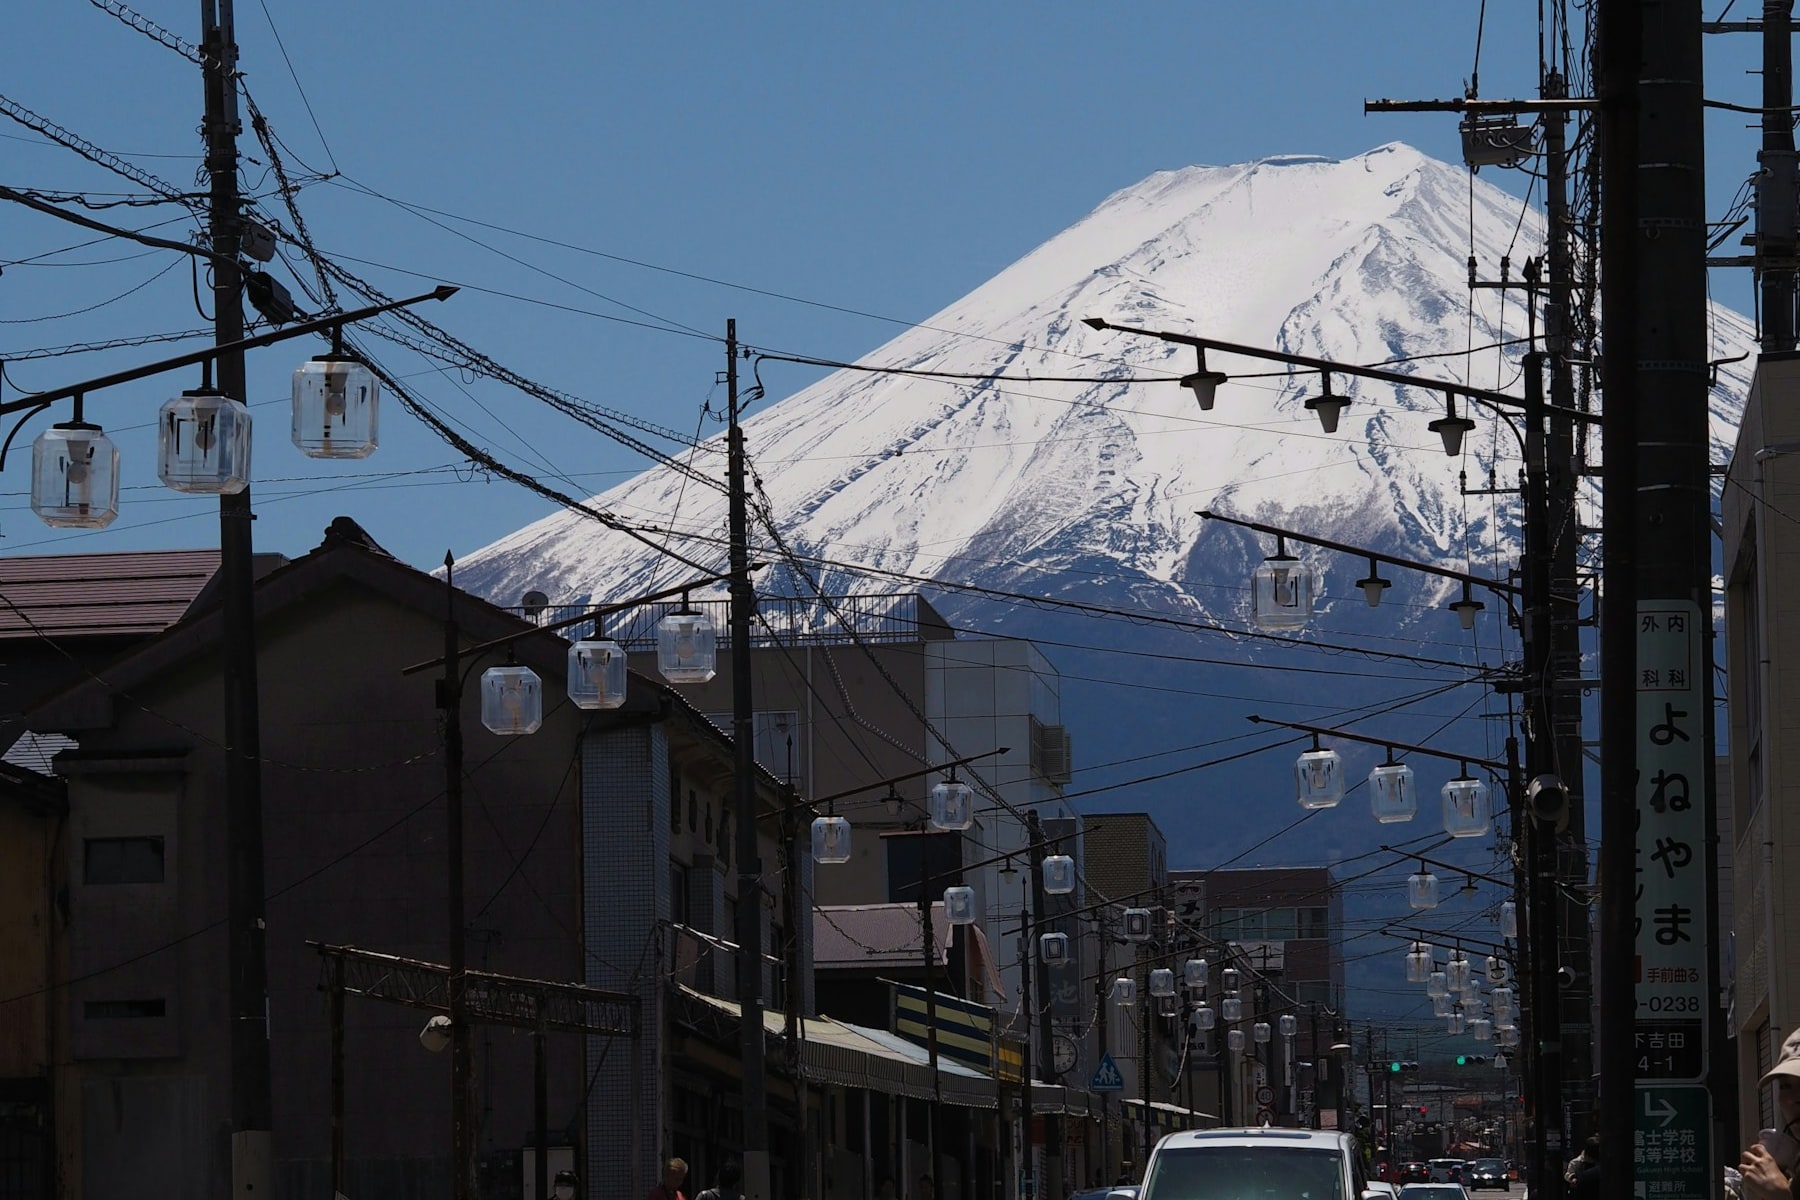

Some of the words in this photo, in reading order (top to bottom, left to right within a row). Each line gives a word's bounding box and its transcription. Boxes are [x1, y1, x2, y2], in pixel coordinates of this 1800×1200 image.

[1650, 702, 1692, 946] よねやま
[1647, 968, 1699, 983] 手前曲る
[1634, 997, 1700, 1012] -0238
[1634, 1032, 1685, 1048] 下吉田
[1637, 1056, 1673, 1072] 4-1
